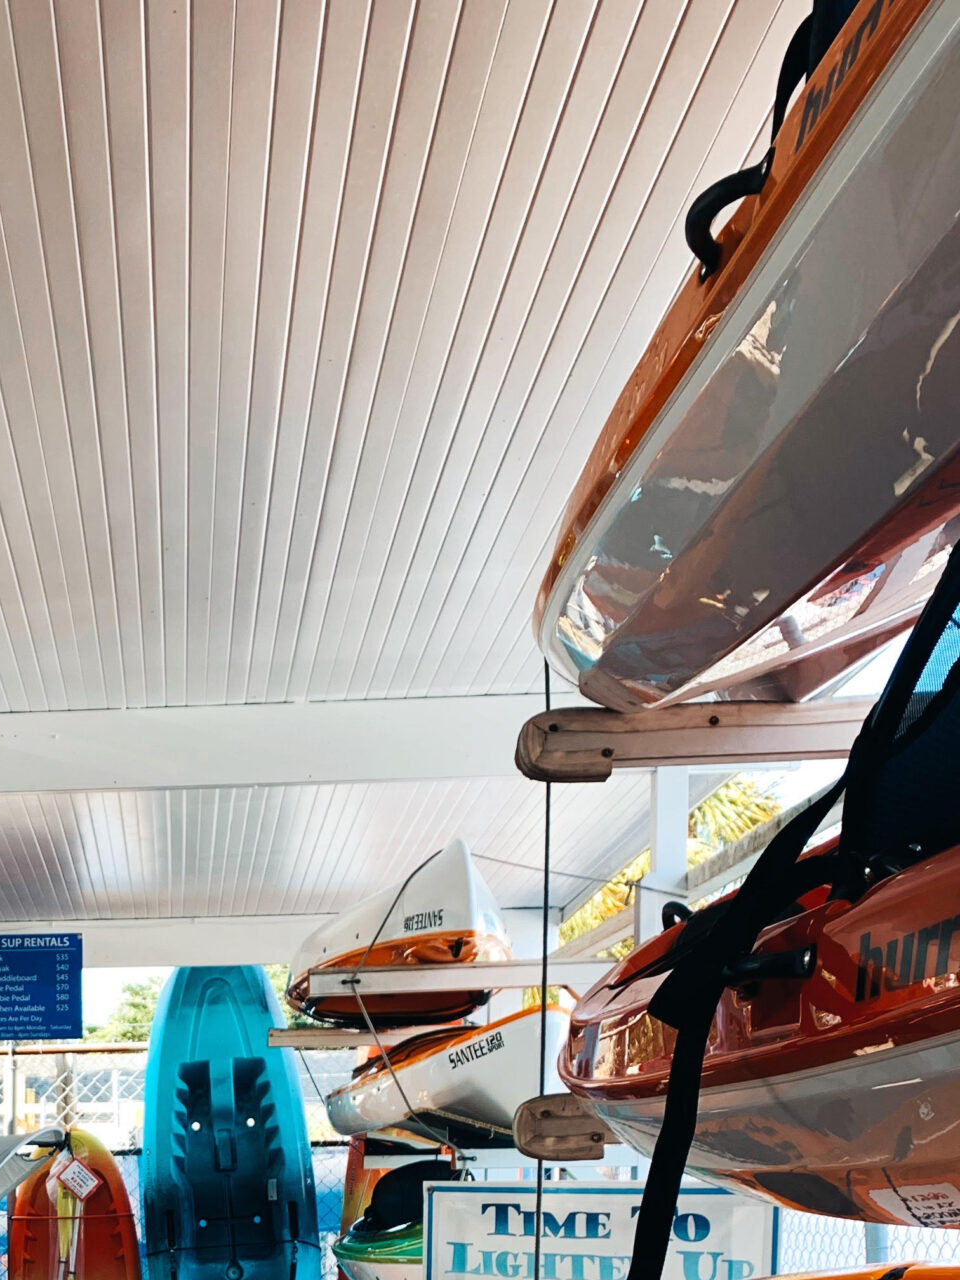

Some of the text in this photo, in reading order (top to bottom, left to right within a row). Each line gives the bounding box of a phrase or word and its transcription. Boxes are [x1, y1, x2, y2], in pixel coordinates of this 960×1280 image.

[414, 908, 444, 931] SANTEE
[1, 937, 22, 948] SUP
[24, 936, 70, 948] RENTALS
[56, 953, 69, 961] $35
[56, 963, 70, 971] $40
[56, 973, 70, 981] $45
[5, 983, 25, 992] Pedal
[56, 983, 70, 991] $70
[11, 993, 31, 1001] Pedal
[14, 1004, 46, 1012] Available
[448, 1031, 503, 1070] SANTEE 120
[481, 1202, 711, 1243] TIME O
